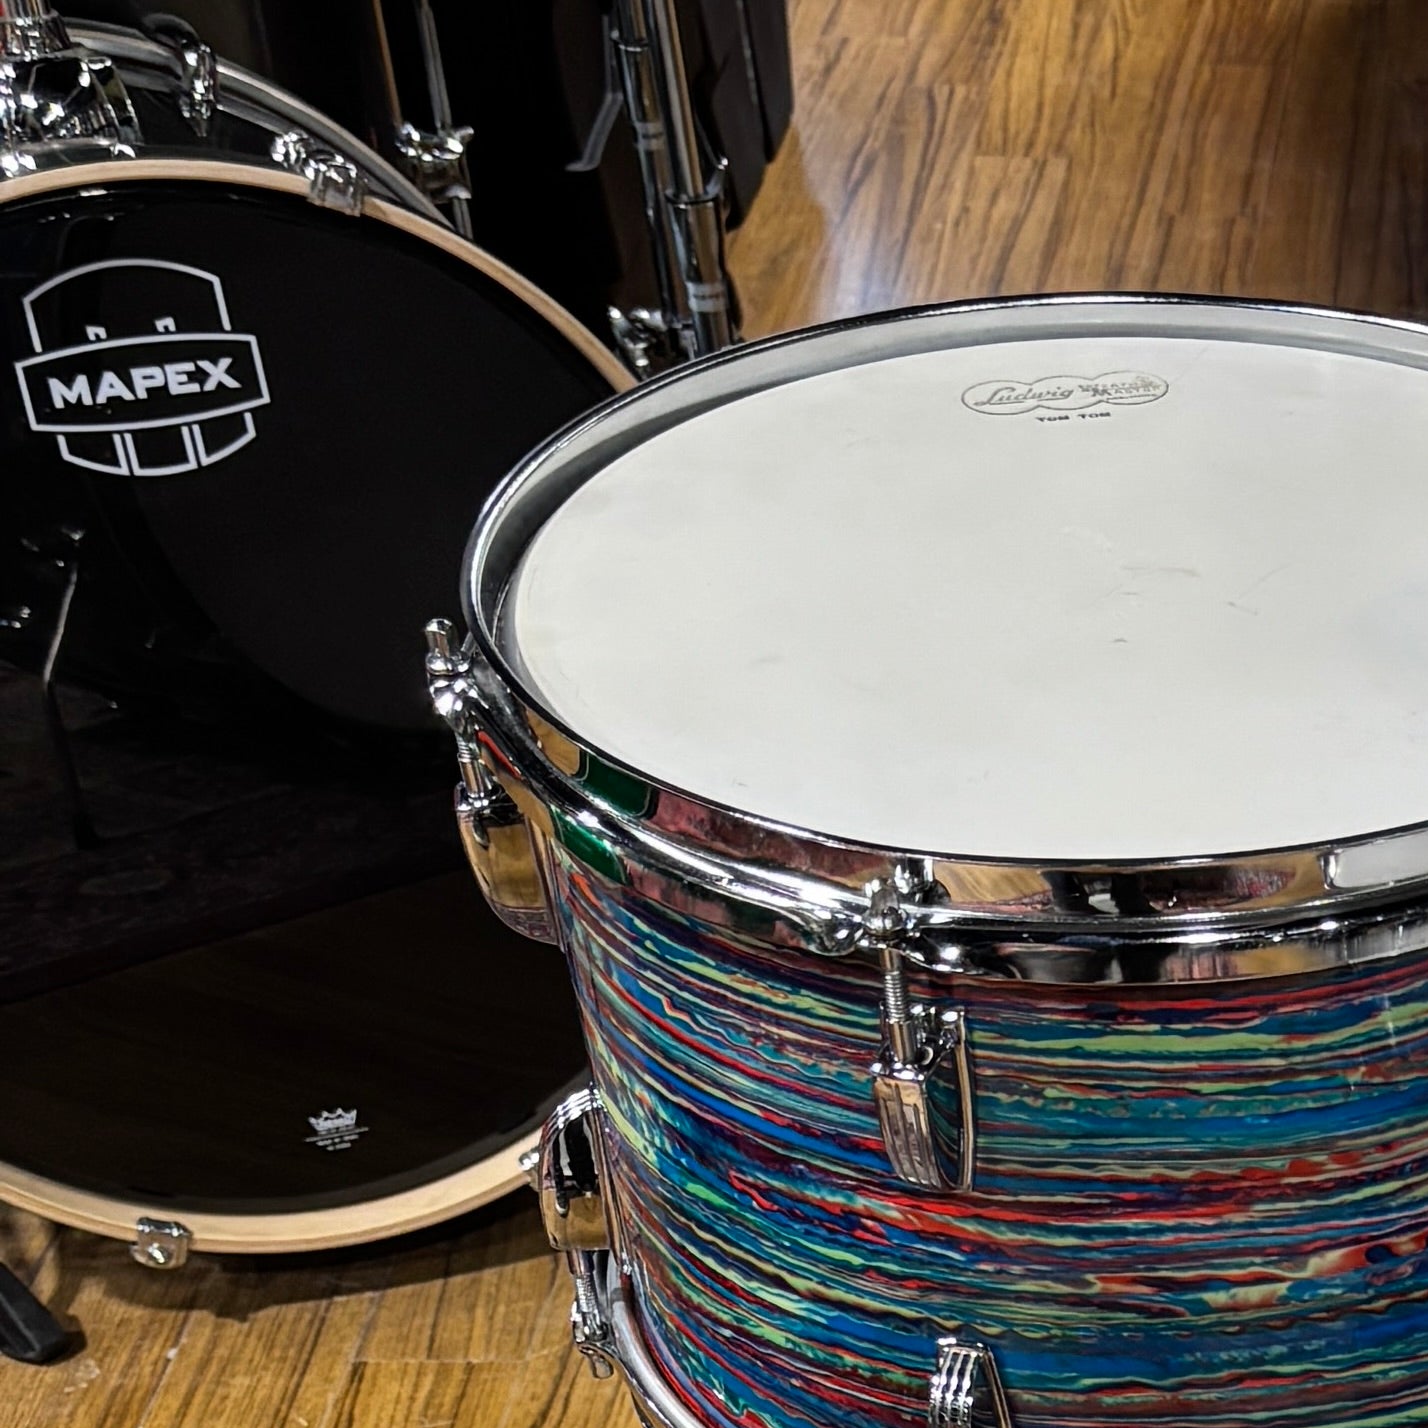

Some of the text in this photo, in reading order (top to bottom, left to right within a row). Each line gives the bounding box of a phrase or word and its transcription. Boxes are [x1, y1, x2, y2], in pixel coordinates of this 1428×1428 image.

[47, 357, 243, 409] MAPEX
[973, 386, 1075, 406] Ludwig
[1078, 411, 1112, 420] TOM
